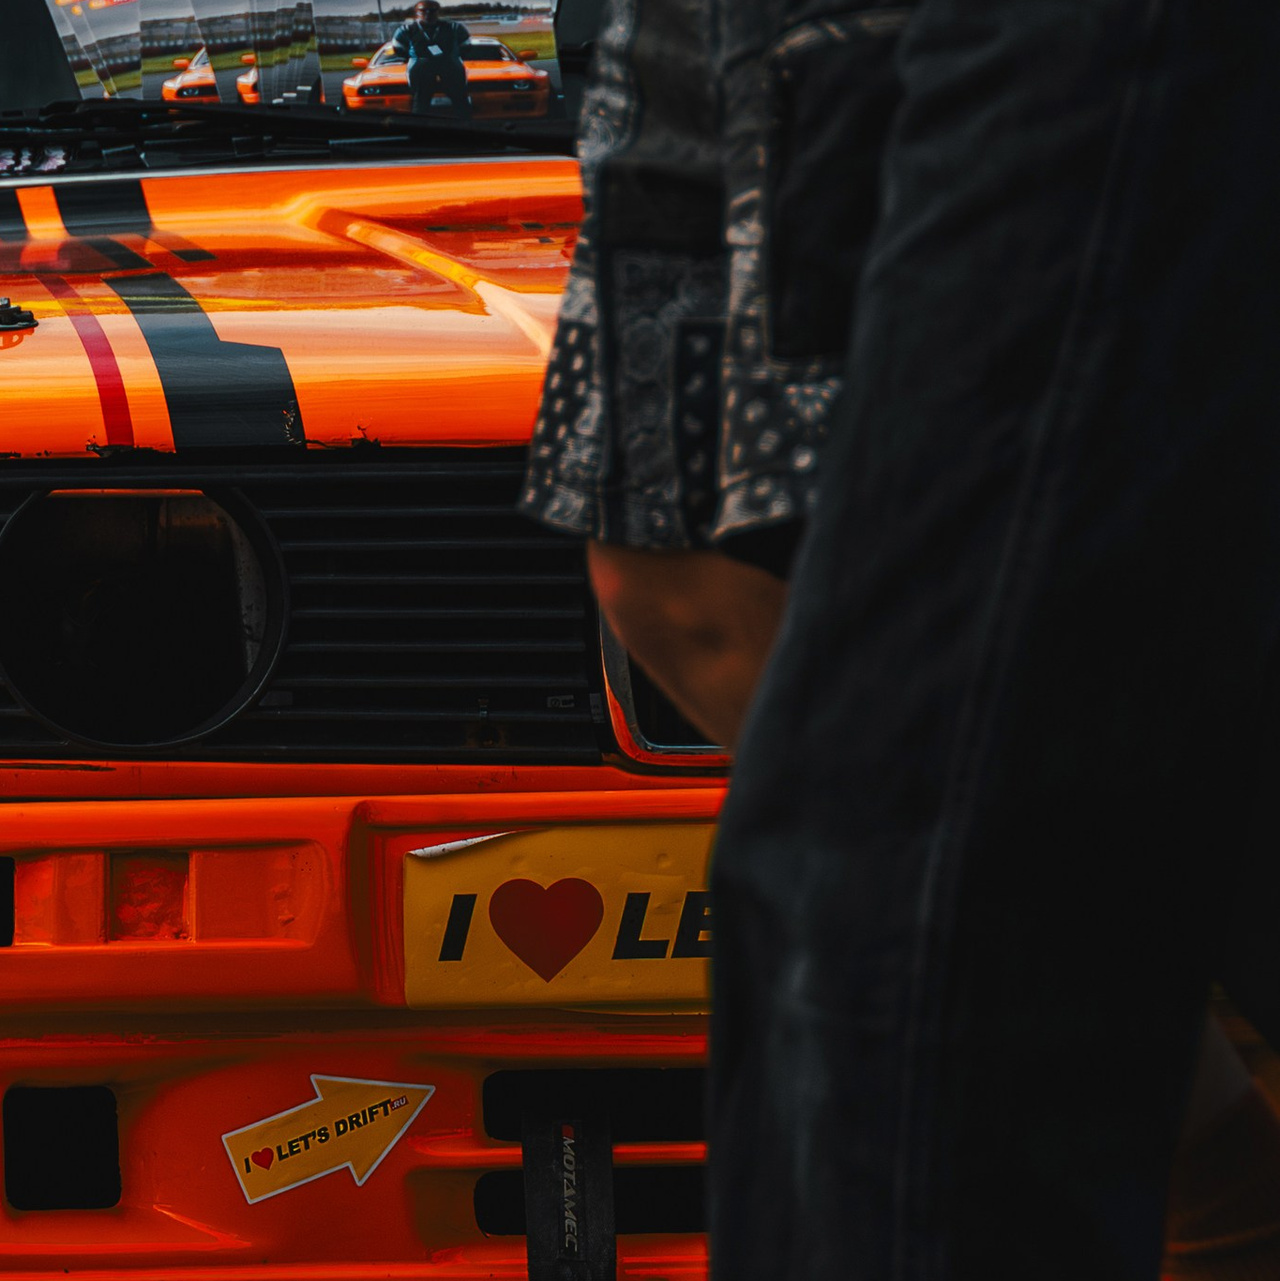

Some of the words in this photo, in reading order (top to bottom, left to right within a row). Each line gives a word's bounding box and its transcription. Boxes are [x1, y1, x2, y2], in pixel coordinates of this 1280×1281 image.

[437, 893, 478, 961] I
[243, 1157, 252, 1174] I
[276, 1126, 330, 1162] LET'S
[562, 1135, 578, 1253] MOTAMEC
